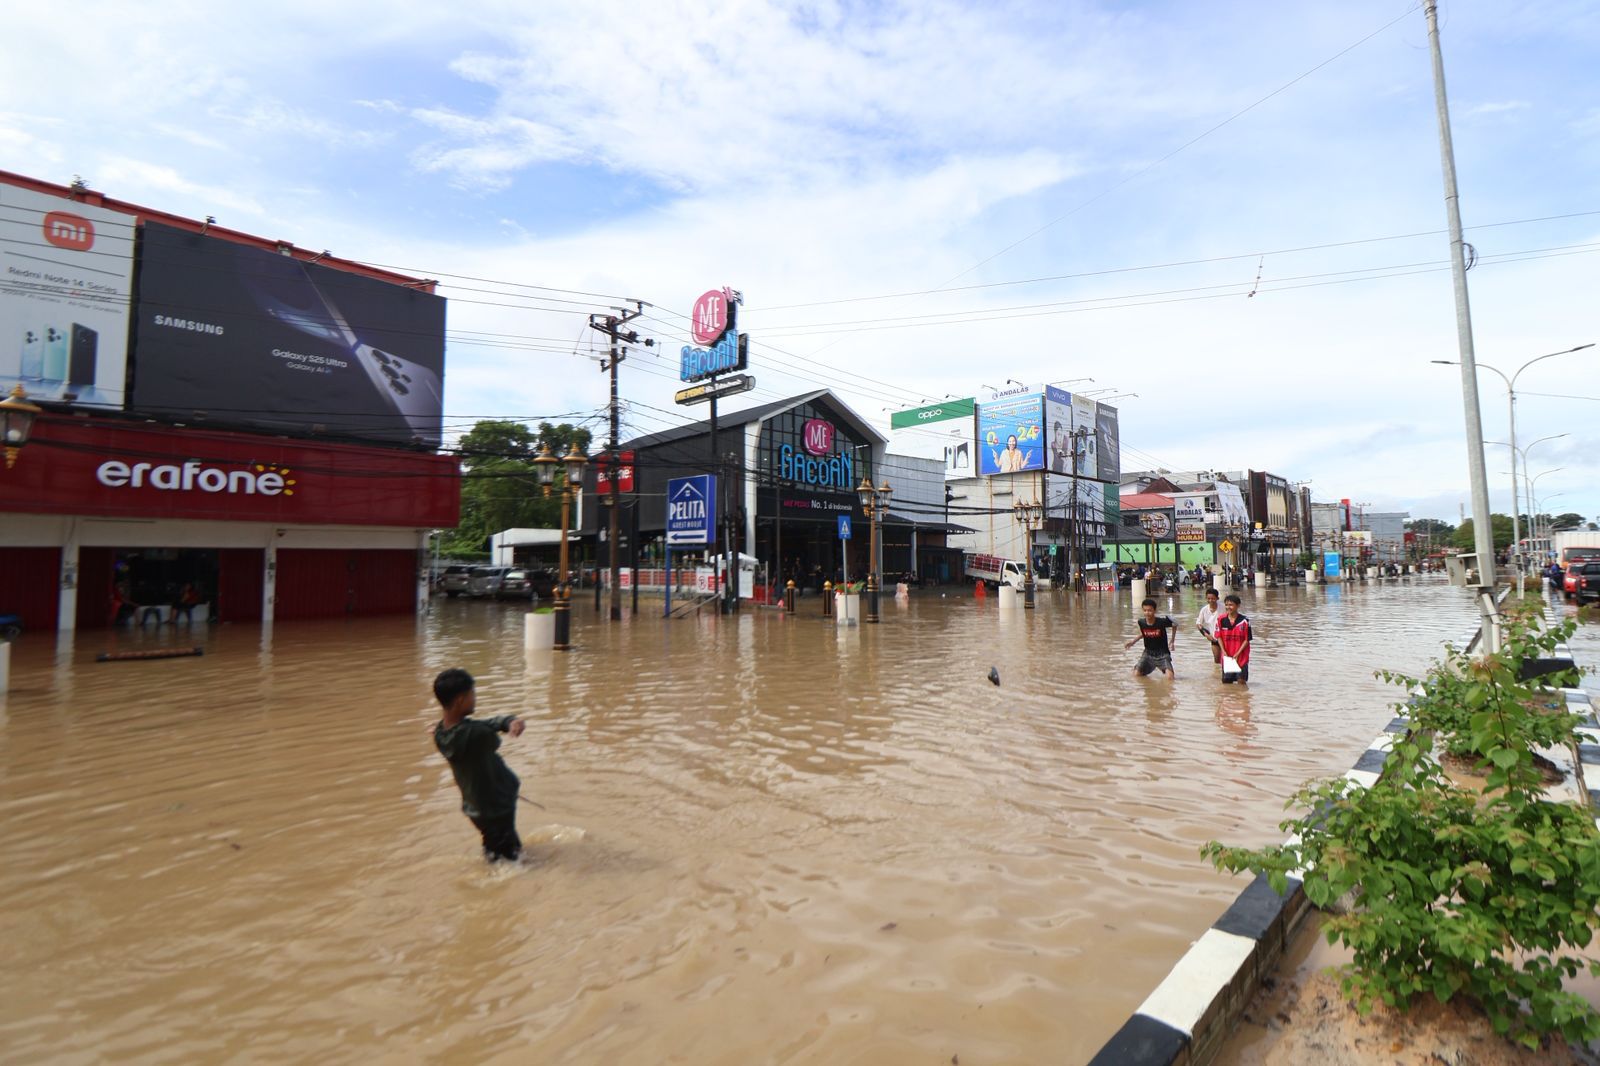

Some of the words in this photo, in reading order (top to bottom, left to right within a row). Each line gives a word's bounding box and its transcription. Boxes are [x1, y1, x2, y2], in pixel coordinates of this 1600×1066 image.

[8, 266, 41, 279] Redmi
[44, 274, 69, 284] Note
[73, 279, 83, 287] 14
[88, 281, 117, 295] Series
[154, 315, 224, 335] SAMSUNG
[272, 349, 308, 362] Galaxy
[309, 355, 325, 364] S25
[326, 358, 347, 368] Ultra
[681, 330, 737, 382] GACOAN
[287, 362, 315, 373] Galaxy
[1000, 386, 1029, 397] ANDALAS
[1052, 391, 1066, 401] vivo
[918, 409, 941, 419] oppo
[781, 444, 852, 489] GACOAN
[96, 460, 285, 496] erafone
[669, 500, 706, 520] PELITA
[811, 500, 822, 509] No.
[824, 501, 828, 509] 1
